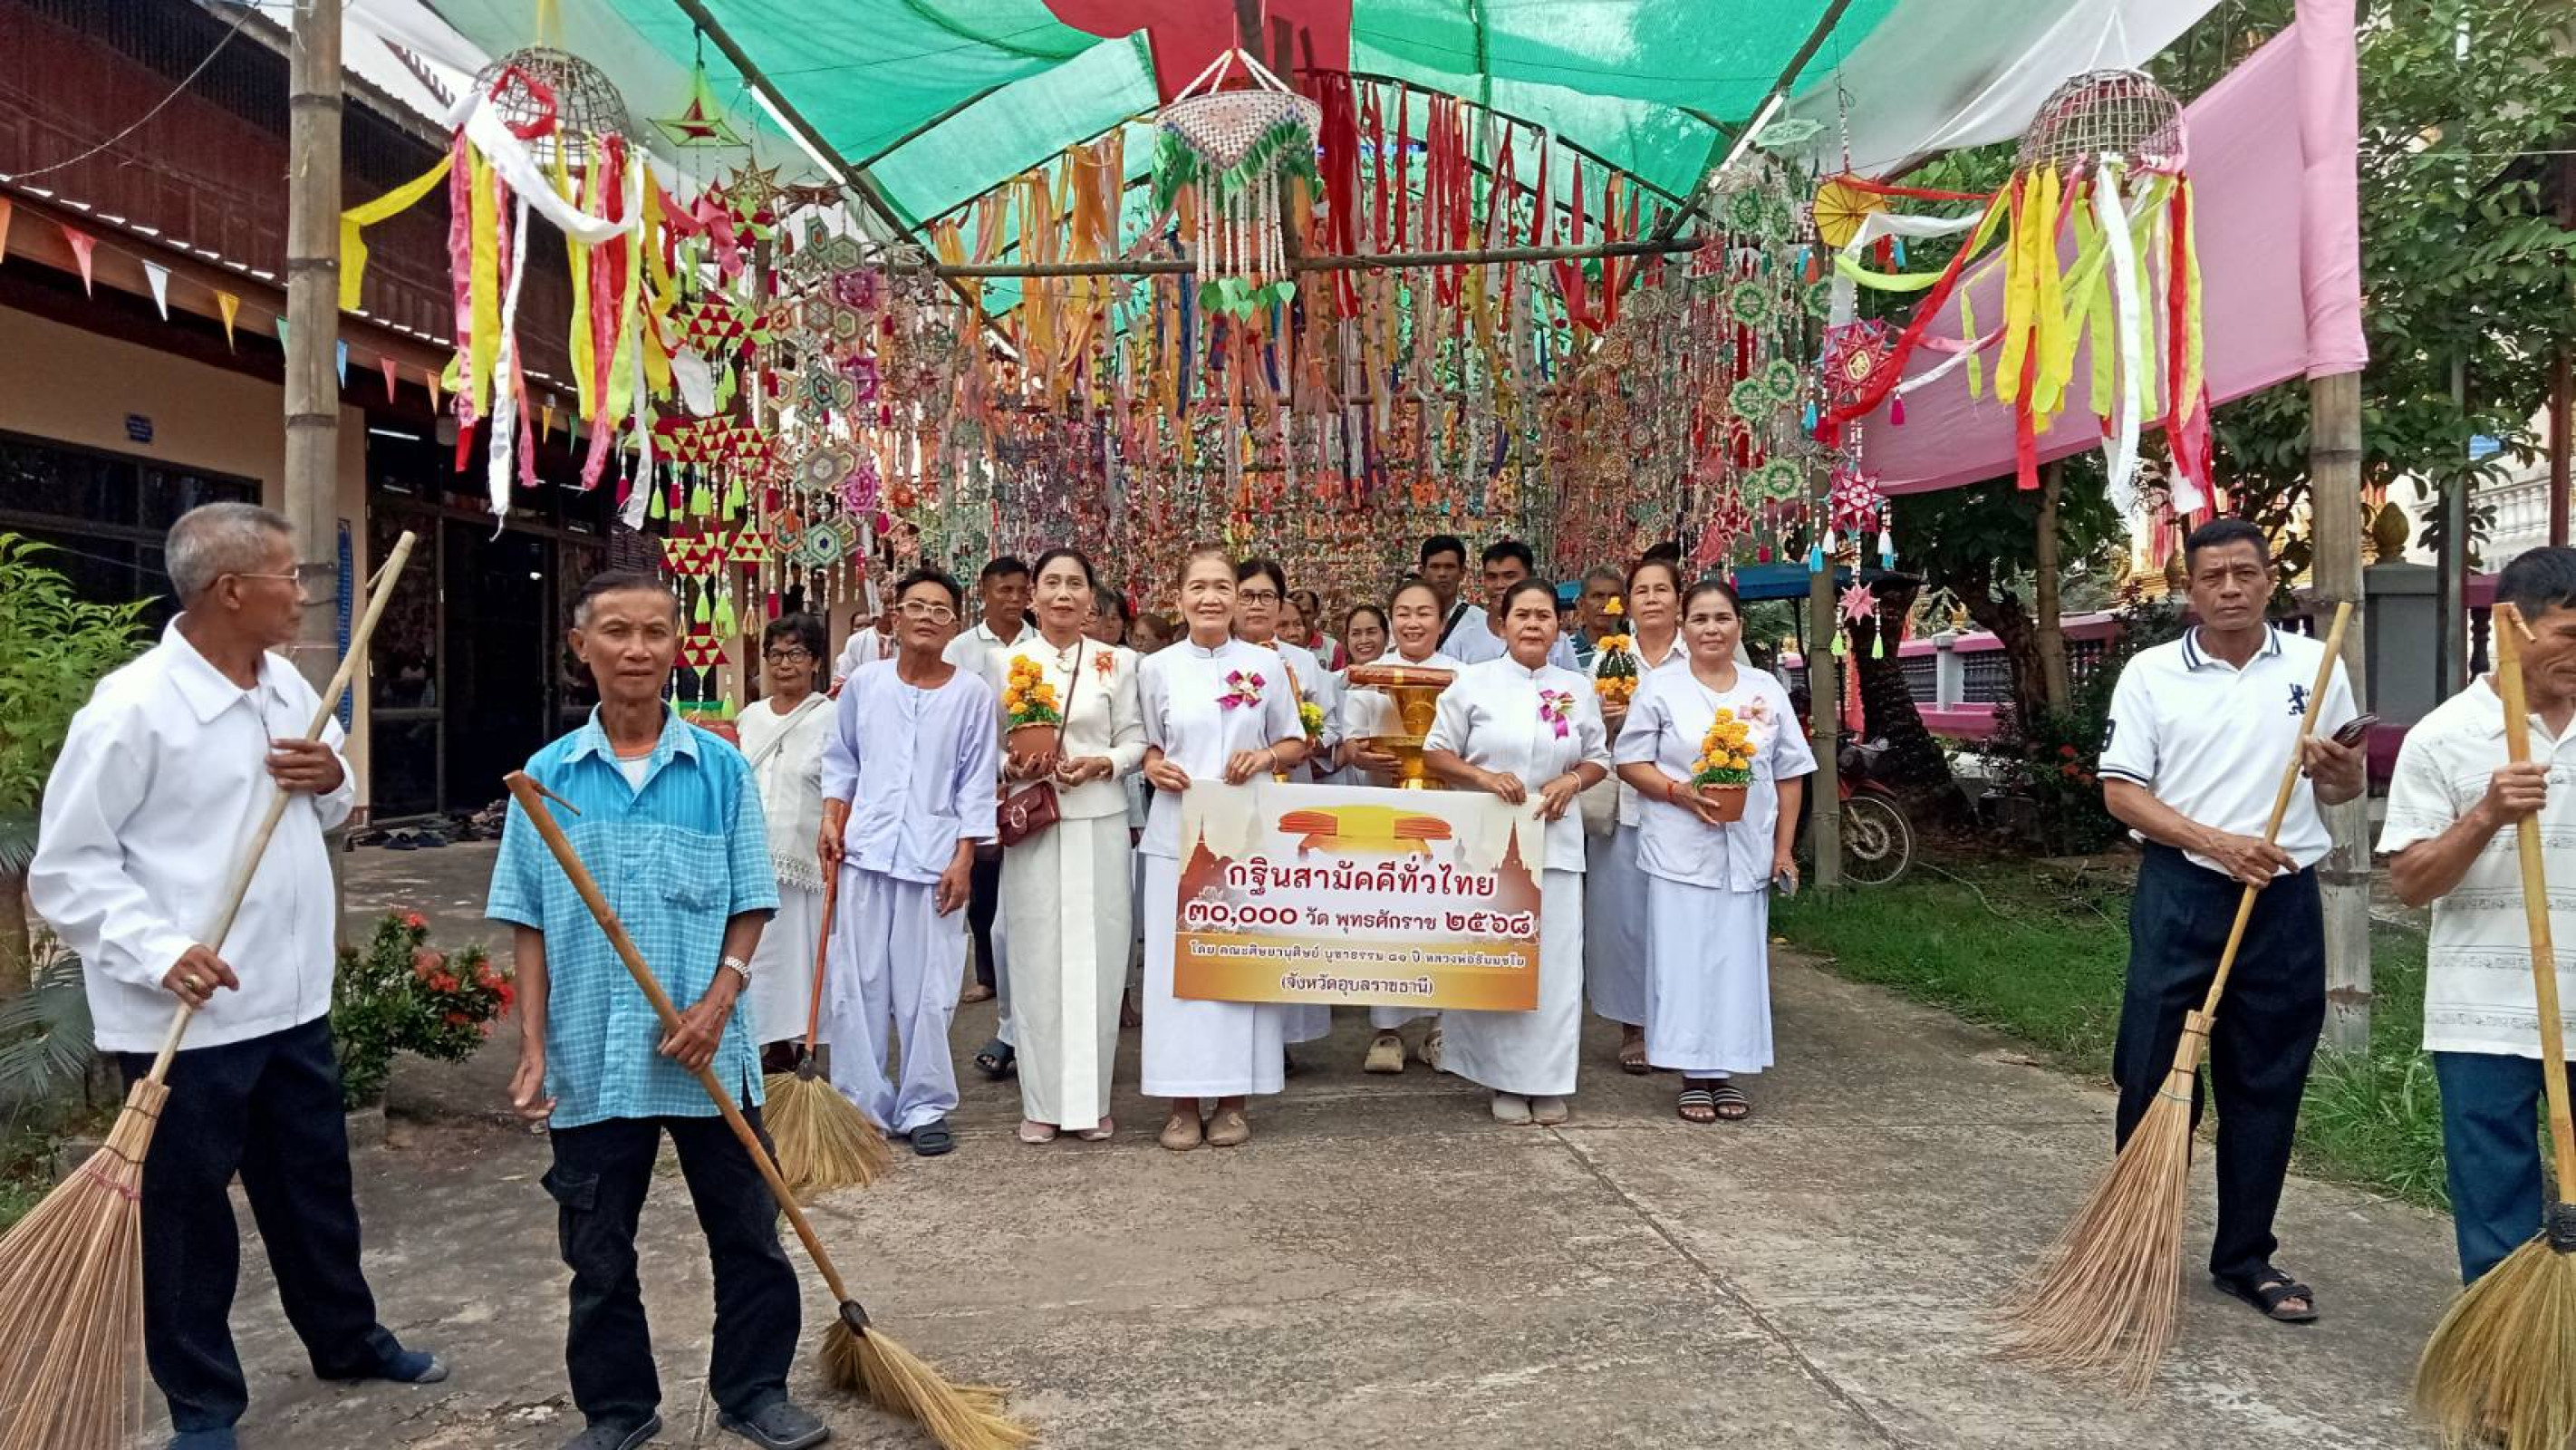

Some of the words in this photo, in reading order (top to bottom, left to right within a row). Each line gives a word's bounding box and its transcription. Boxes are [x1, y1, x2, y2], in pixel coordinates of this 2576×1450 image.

[1230, 855, 1494, 896] กฐินสามัคคีทั่วไทย
[1188, 904, 1298, 926] ๓๐,๐๐๐
[1306, 906, 1329, 926] วัด
[1336, 909, 1437, 933] พุทธศักราช
[1444, 911, 1530, 934] ๒๕๖๘
[1191, 942, 1215, 954] โดย
[1411, 950, 1421, 963] ปี
[1281, 972, 1433, 997] (จังหวัดอุบลราชธานี)
